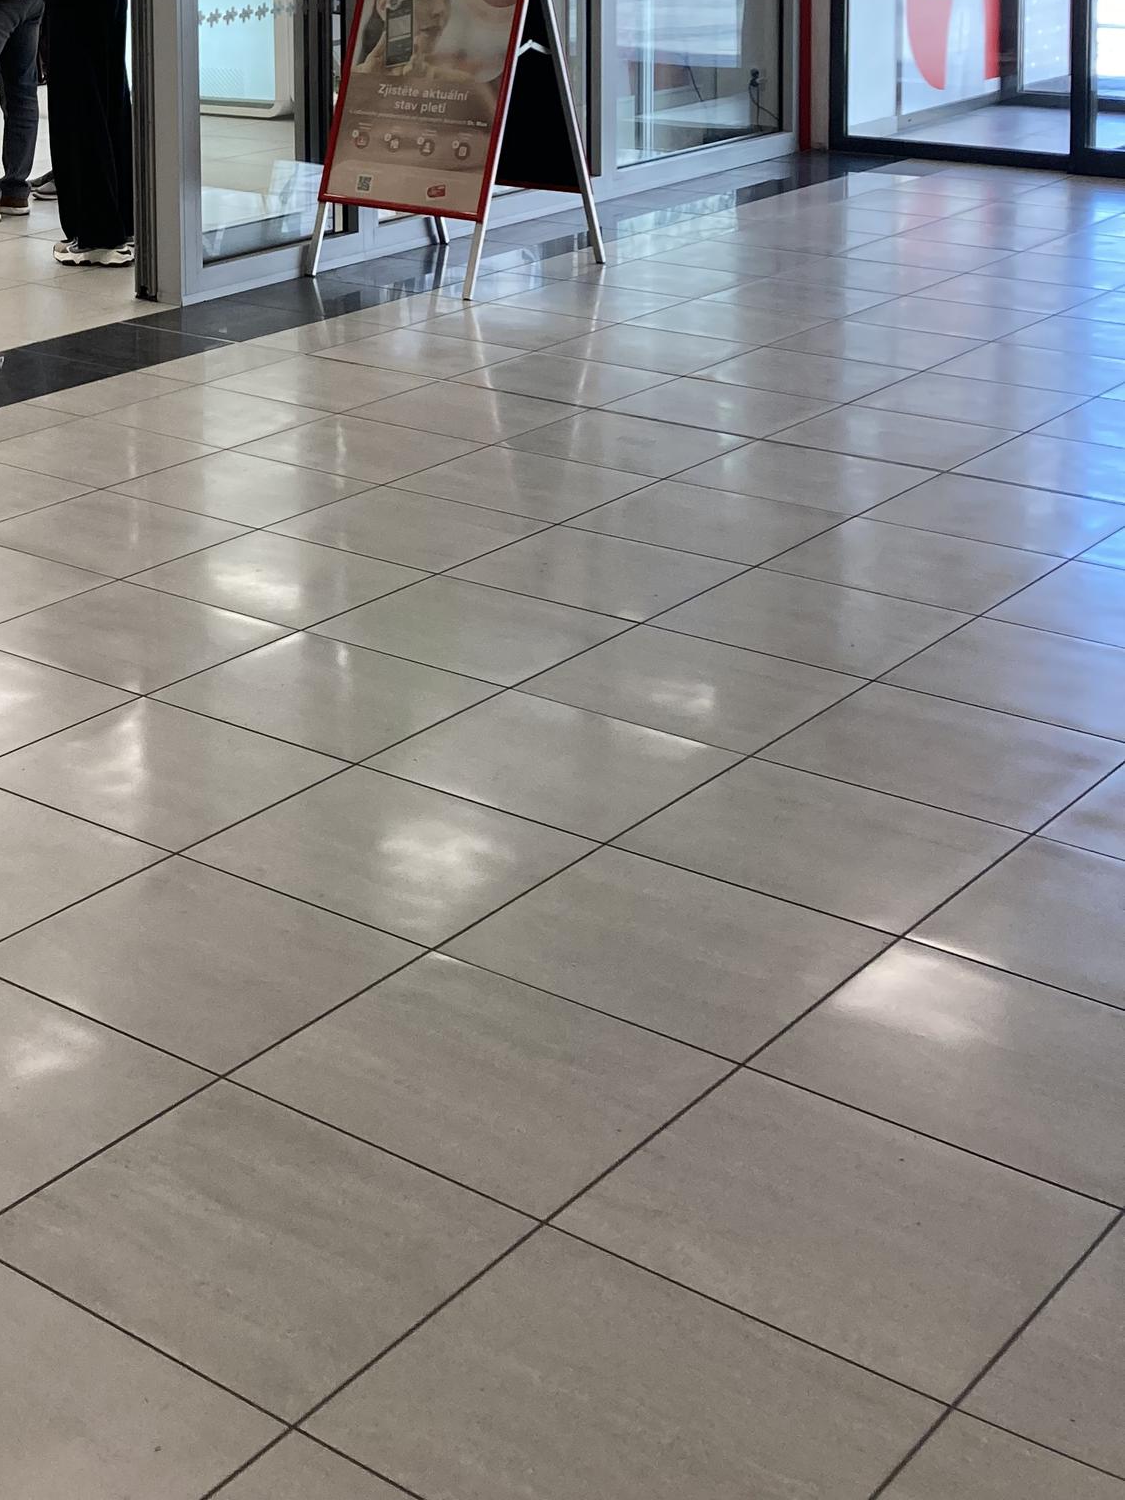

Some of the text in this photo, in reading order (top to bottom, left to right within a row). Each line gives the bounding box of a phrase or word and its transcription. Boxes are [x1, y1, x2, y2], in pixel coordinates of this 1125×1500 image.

[377, 83, 470, 101] Zjistěte aktuální
[394, 100, 417, 111] stav
